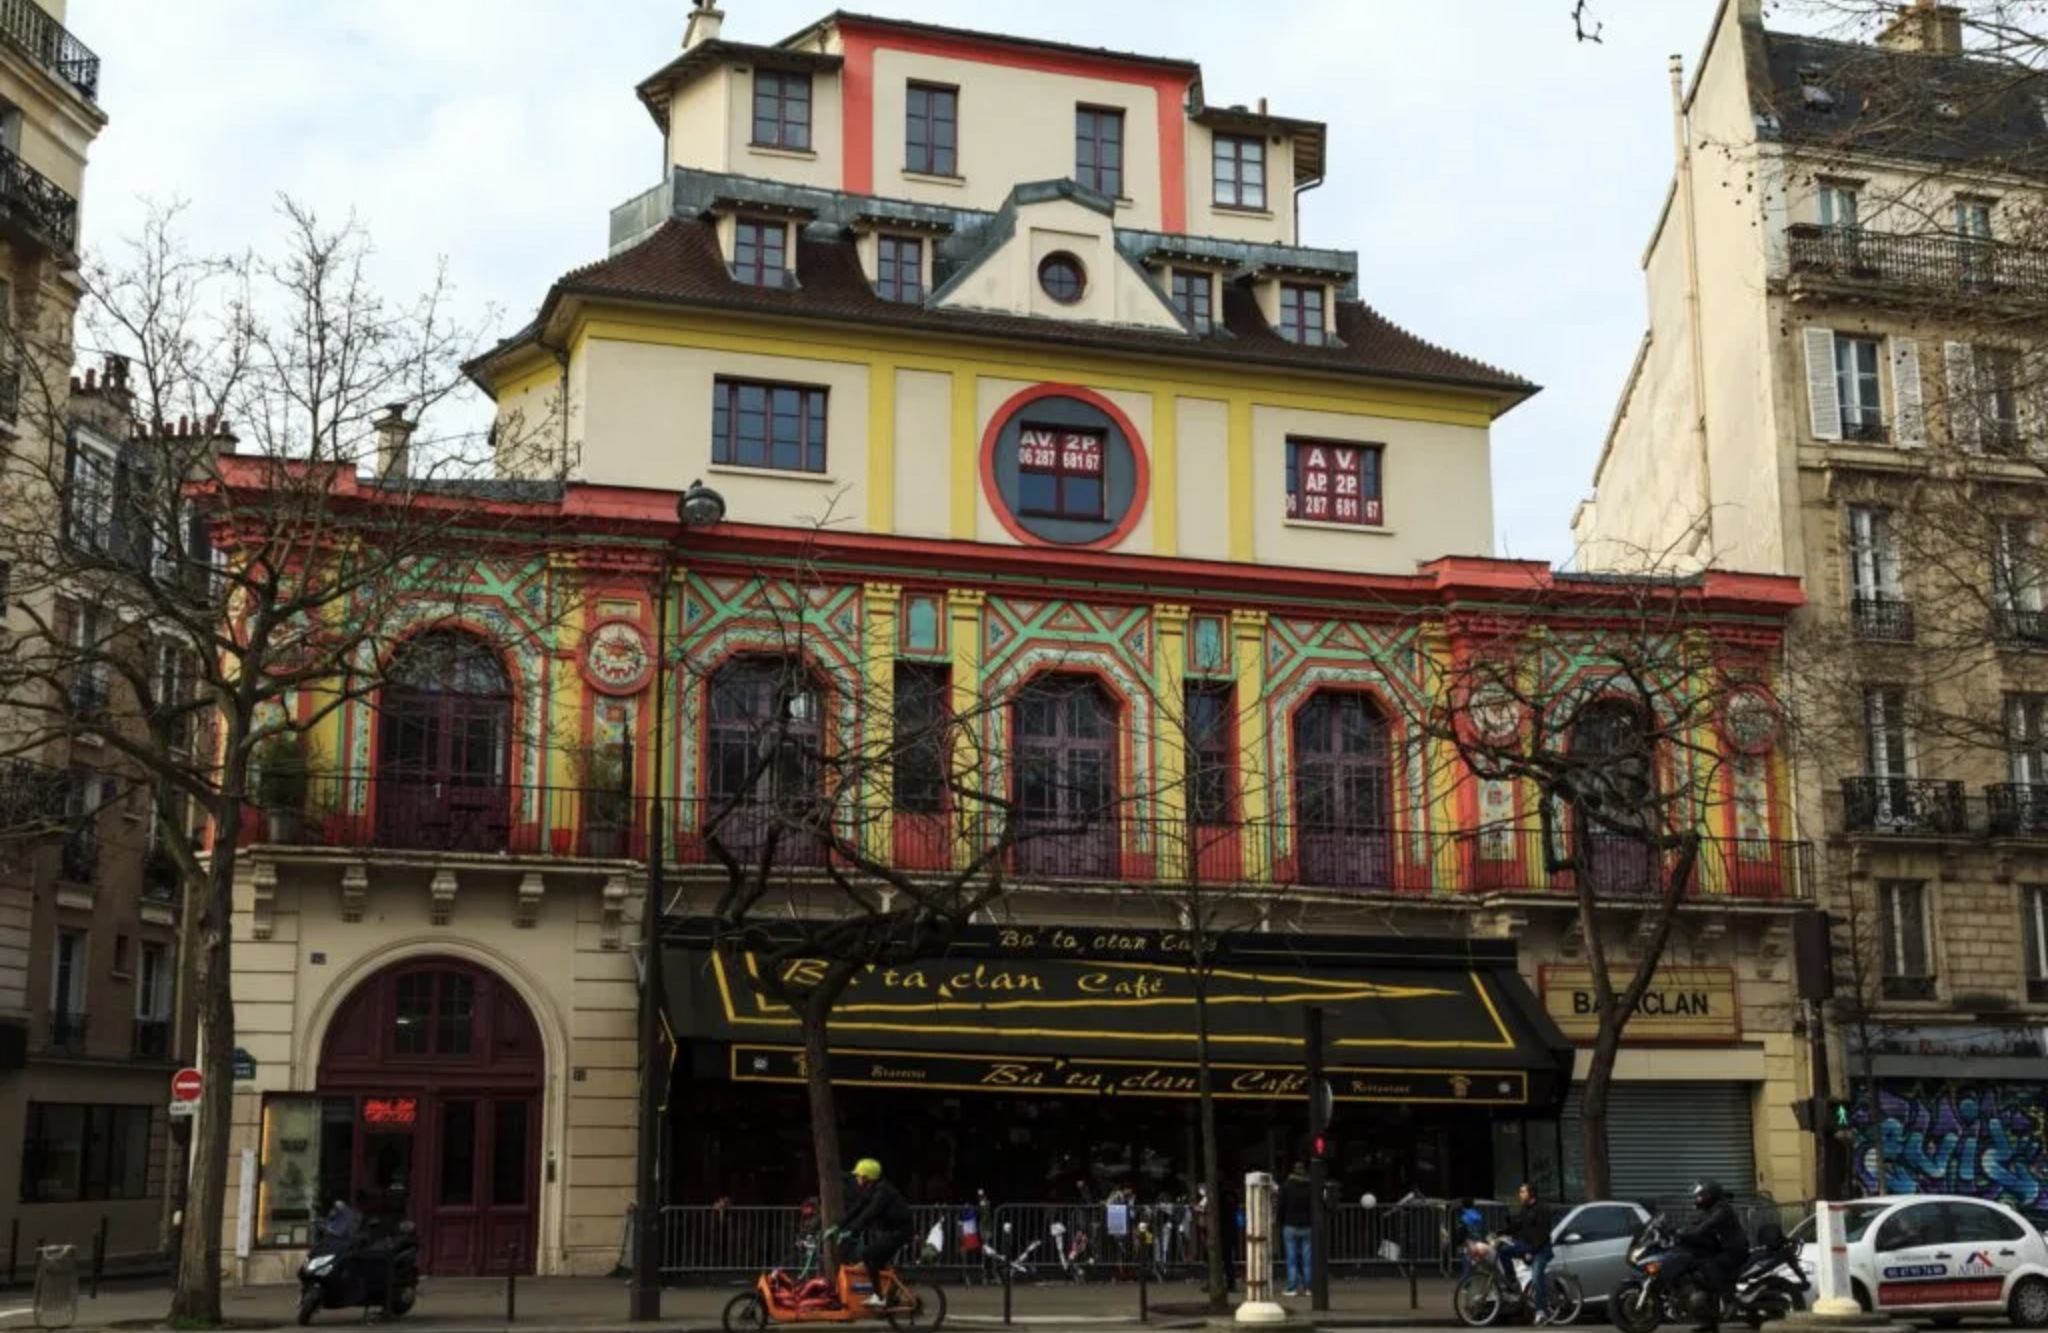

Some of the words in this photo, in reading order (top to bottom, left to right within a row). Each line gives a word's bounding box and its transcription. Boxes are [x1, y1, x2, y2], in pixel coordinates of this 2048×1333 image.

[1021, 431, 1054, 448] AV.
[1065, 434, 1097, 452] 2P.
[1035, 450, 1056, 466] 287
[1085, 454, 1100, 471] 67
[1305, 495, 1327, 514] 287
[1367, 500, 1379, 518] 67
[1077, 972, 1164, 998] Café
[1231, 1070, 1309, 1094] Café
